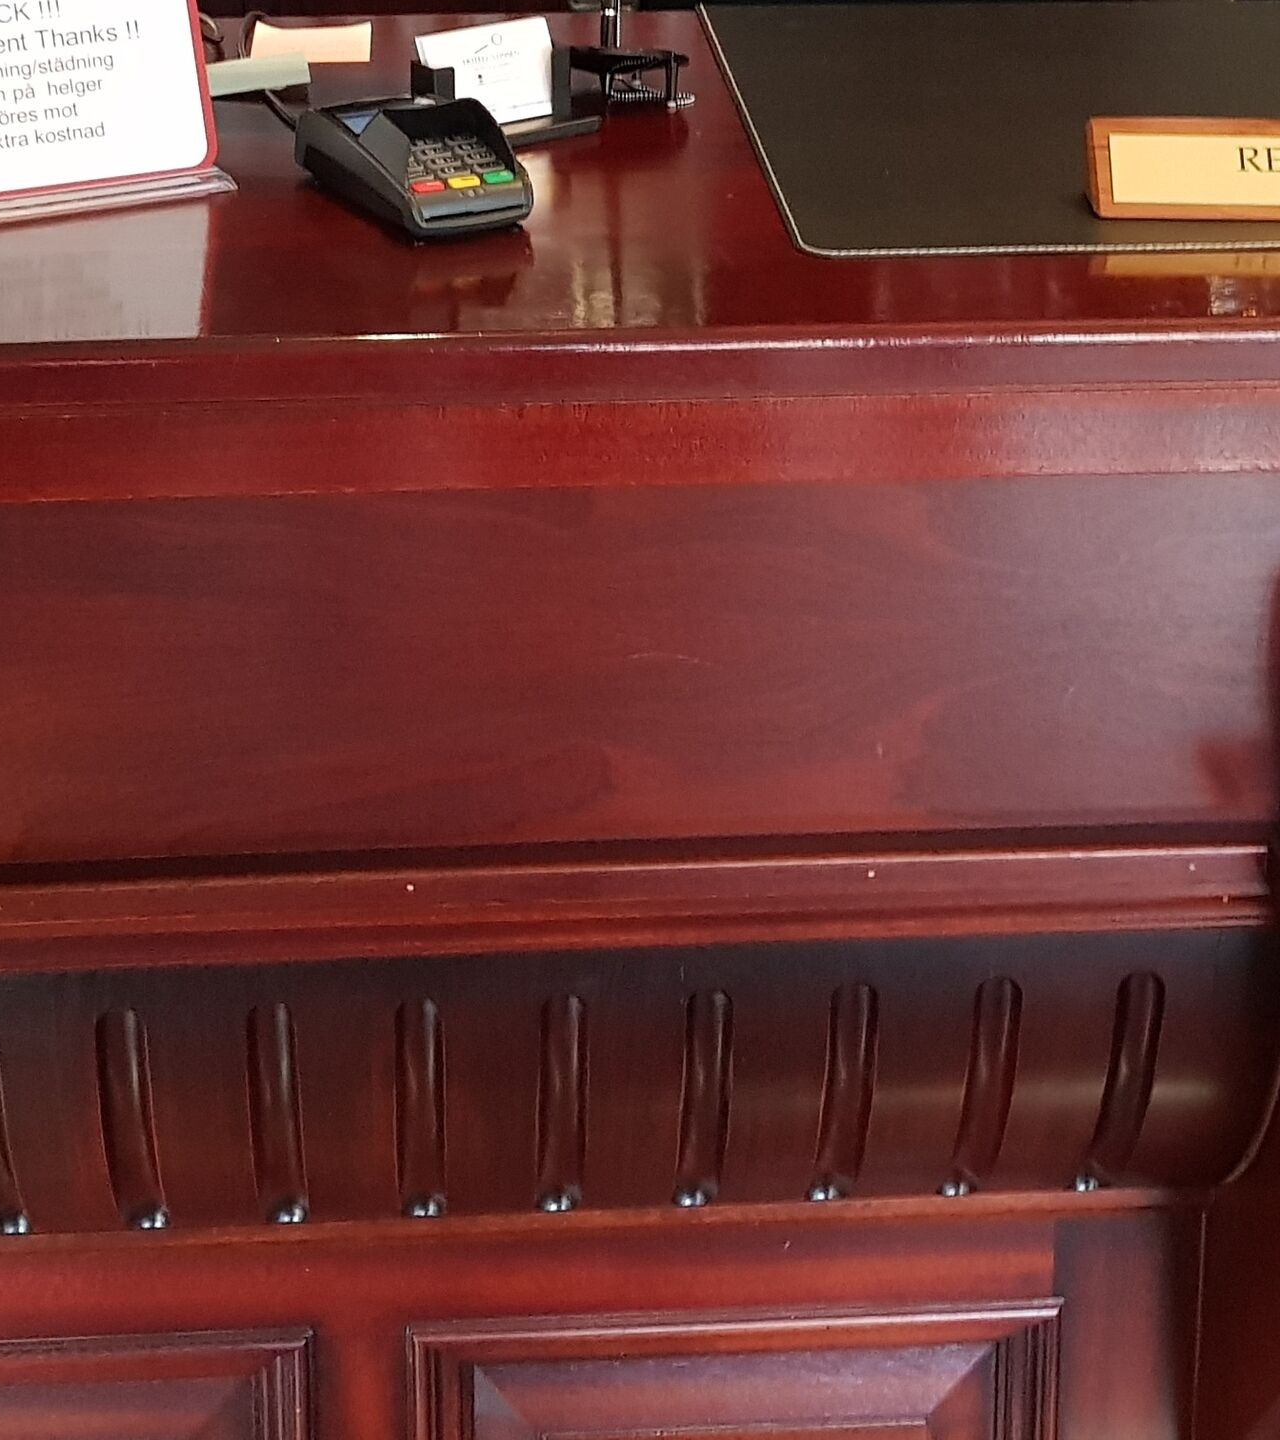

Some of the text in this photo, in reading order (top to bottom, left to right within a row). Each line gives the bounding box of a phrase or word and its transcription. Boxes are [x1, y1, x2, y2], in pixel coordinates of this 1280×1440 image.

[39, 0, 61, 20] !!!
[35, 24, 118, 51] Thanks
[126, 20, 140, 40] !!
[13, 83, 36, 107] på
[47, 76, 104, 100] helger
[44, 103, 79, 120] mot
[35, 123, 106, 145] kostnad
